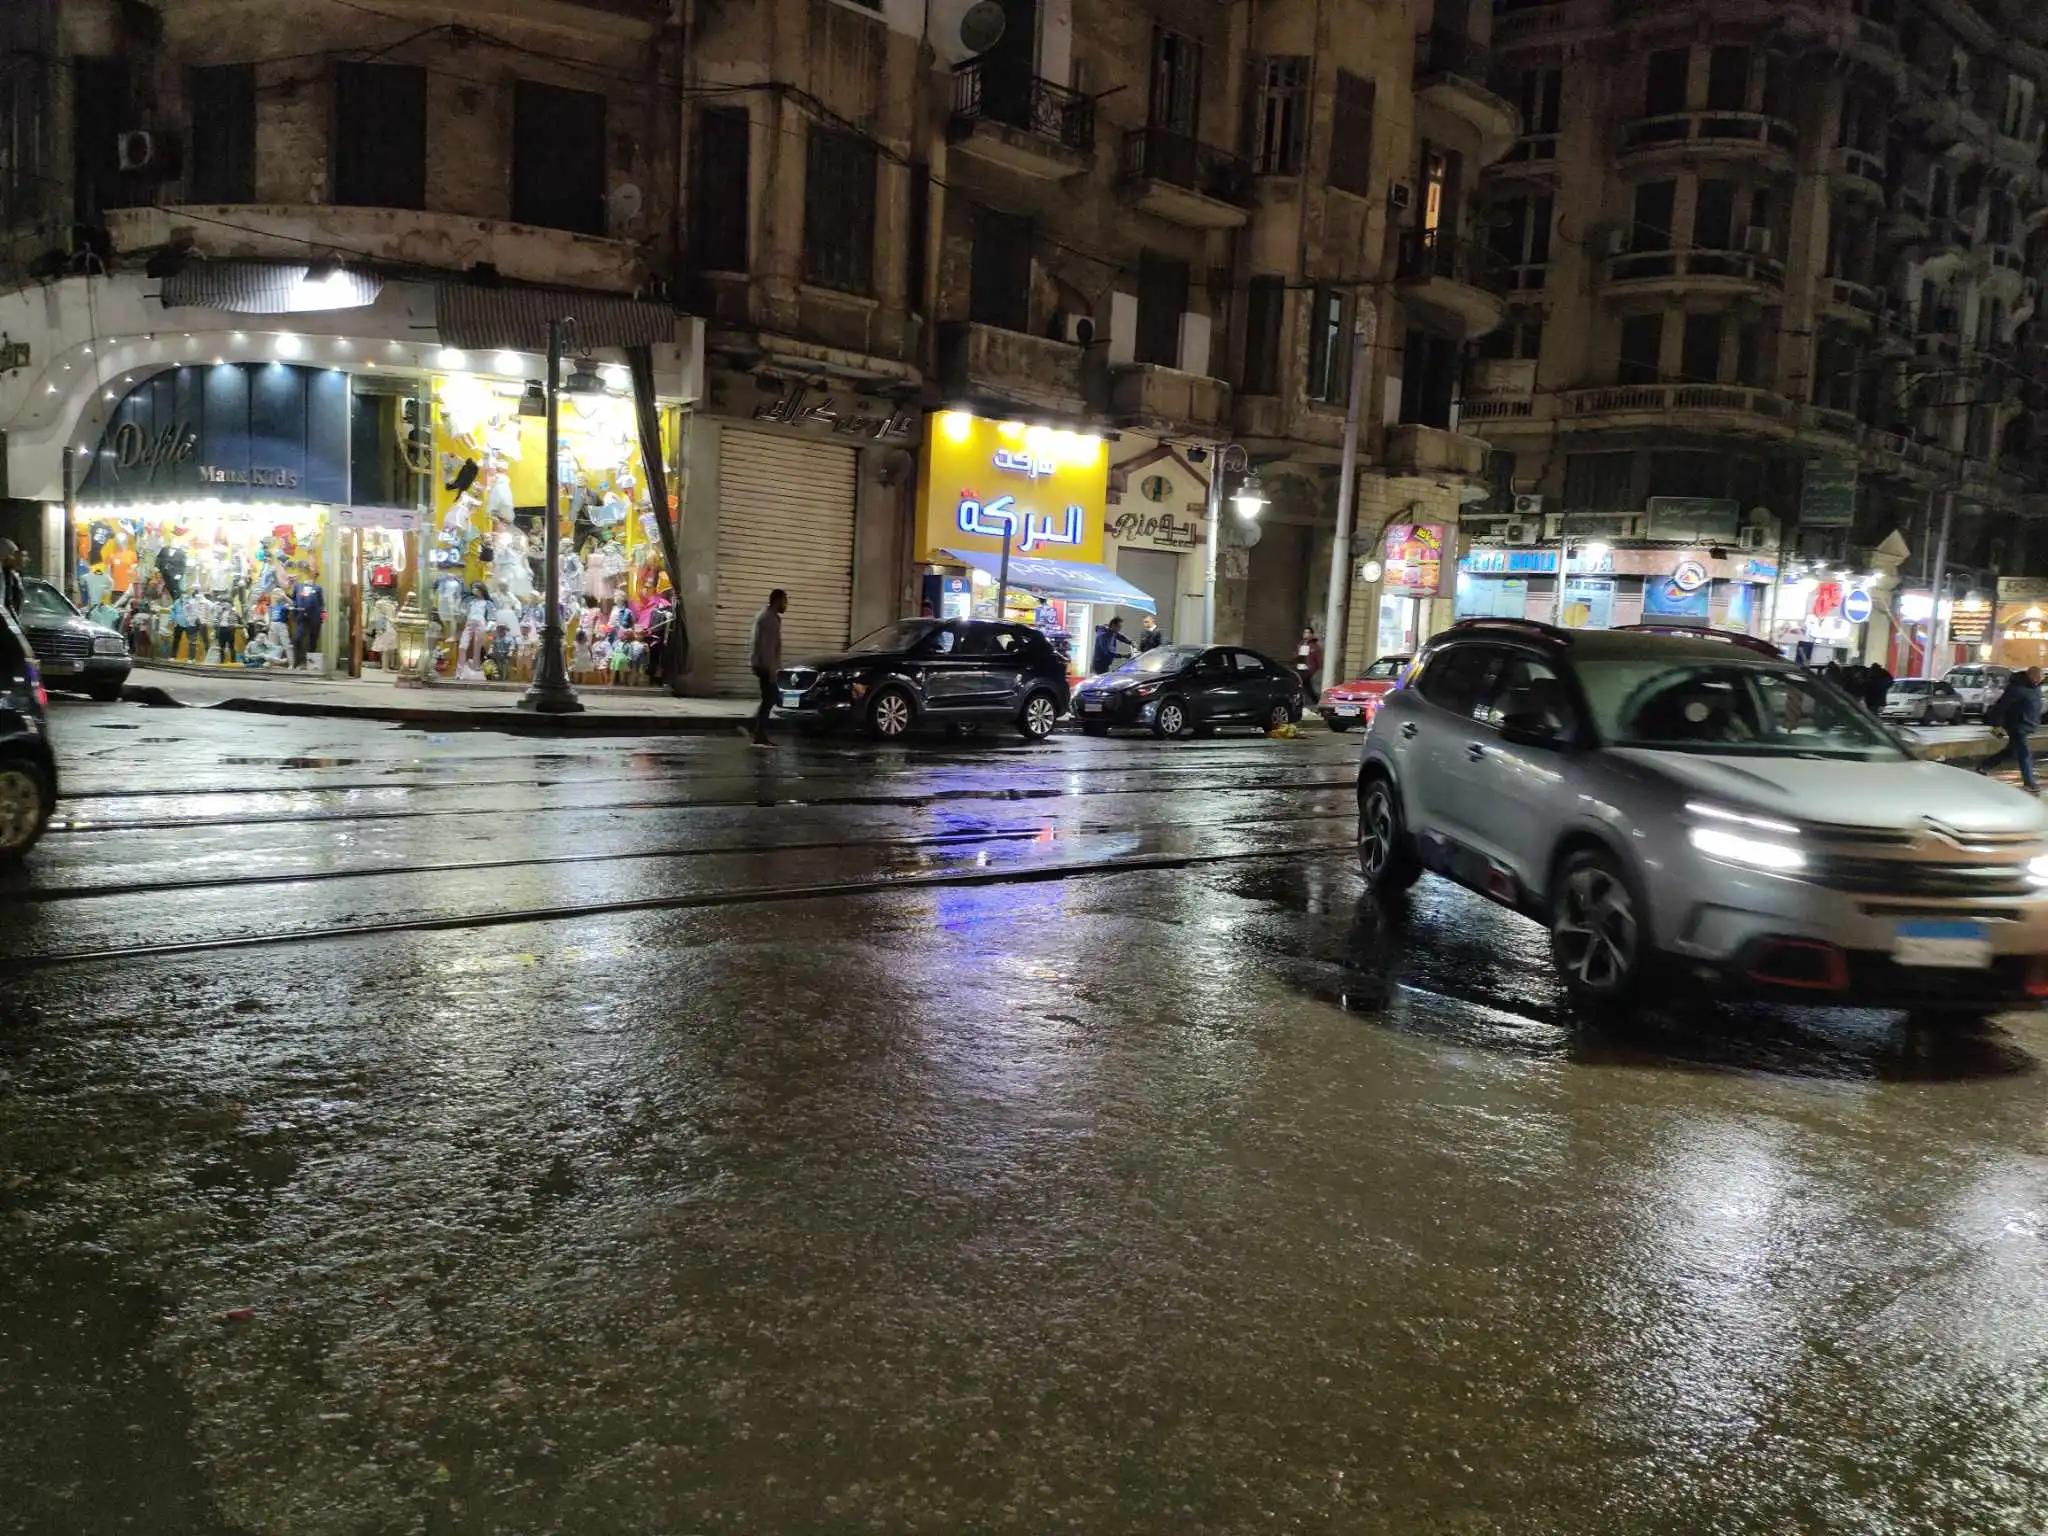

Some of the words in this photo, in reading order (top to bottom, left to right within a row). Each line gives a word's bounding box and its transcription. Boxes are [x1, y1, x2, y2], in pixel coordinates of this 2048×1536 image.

[251, 467, 298, 488] Kids
[958, 488, 1083, 551] البركة
[1112, 513, 1157, 541] Rio
